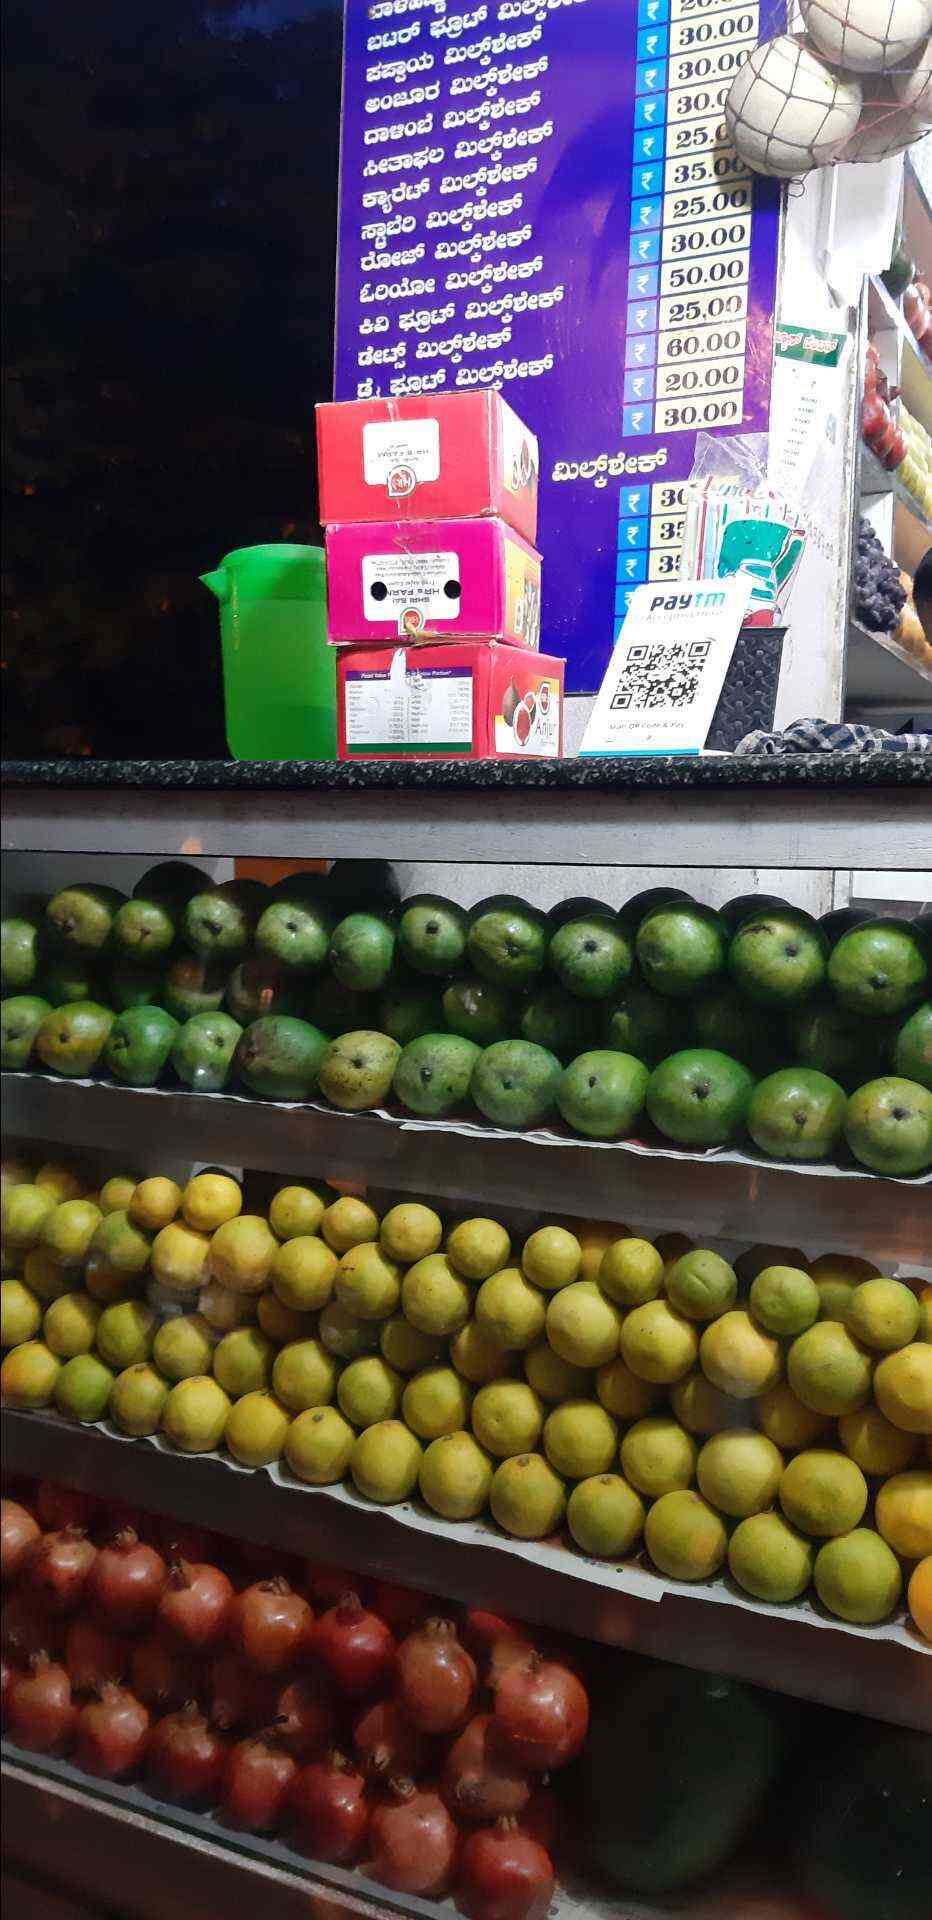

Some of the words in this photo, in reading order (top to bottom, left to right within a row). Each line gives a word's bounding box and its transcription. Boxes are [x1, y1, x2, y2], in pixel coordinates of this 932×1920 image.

[366, 21, 421, 51] ಬಟರ್
[679, 14, 754, 46] 30.00
[677, 88, 731, 114] 30.0
[675, 123, 730, 150] 25.0
[673, 189, 748, 219] 25.00
[671, 224, 746, 253] 30.00
[669, 260, 744, 288] 50.00
[667, 330, 741, 358] 60.00
[665, 365, 739, 392] 20.00
[664, 401, 738, 427] 30.00
